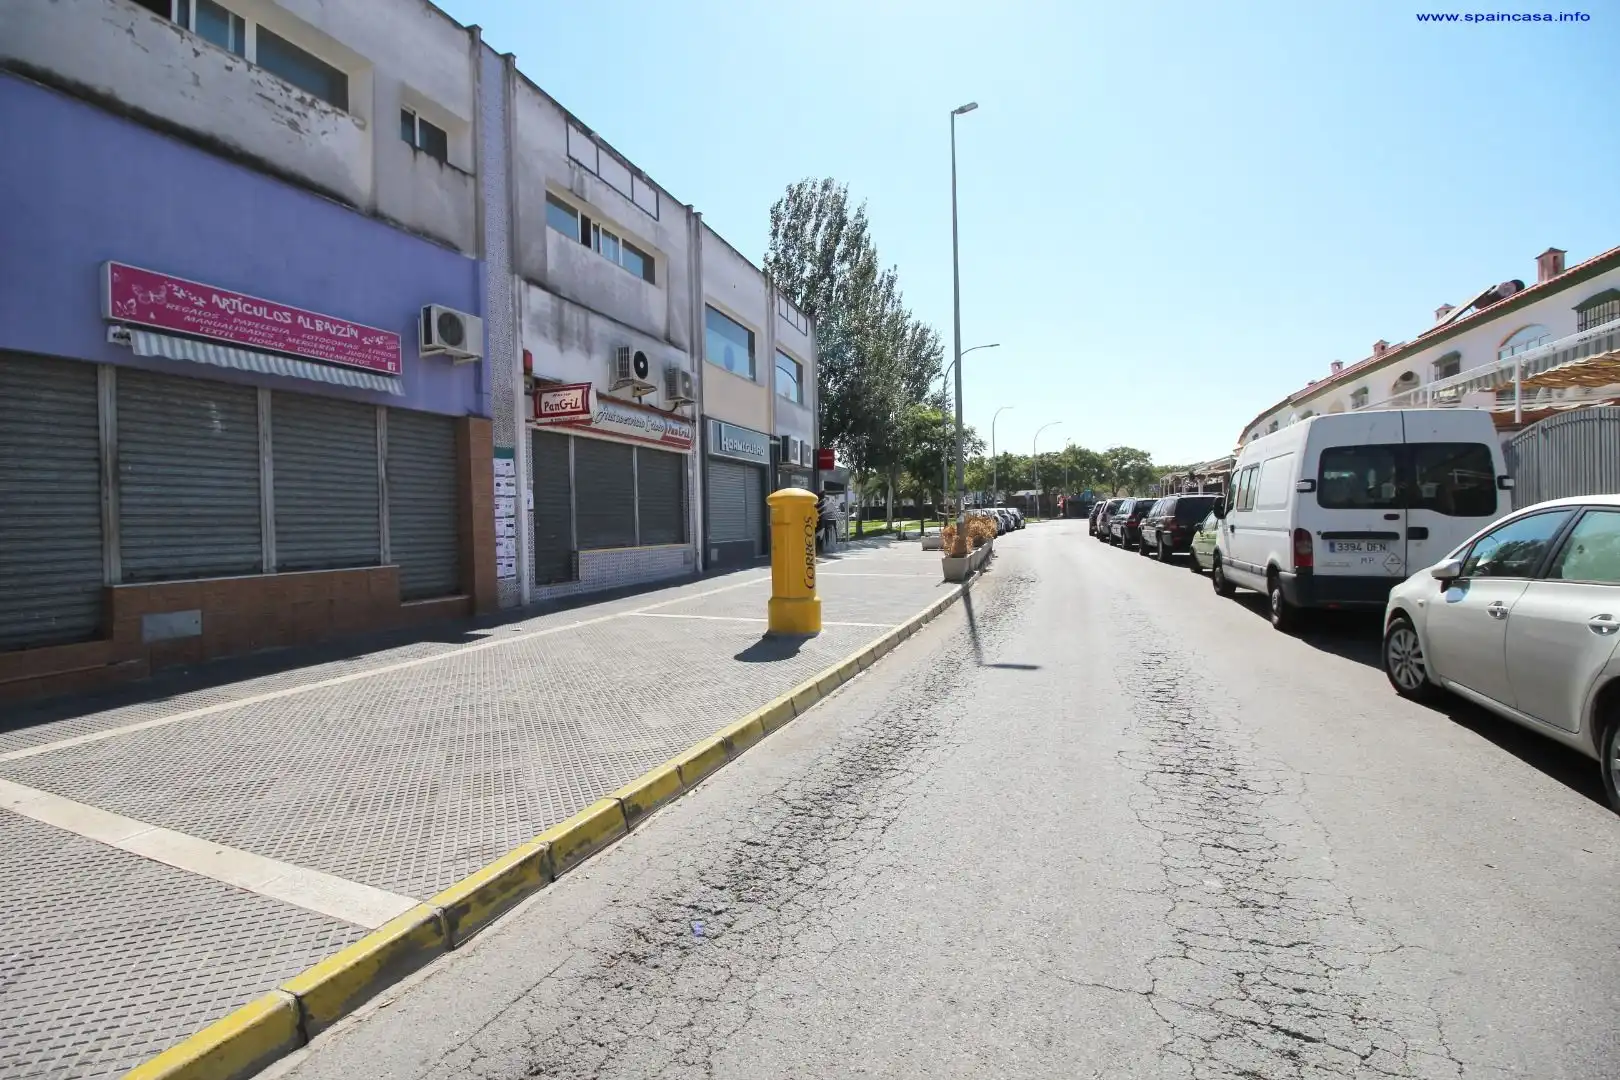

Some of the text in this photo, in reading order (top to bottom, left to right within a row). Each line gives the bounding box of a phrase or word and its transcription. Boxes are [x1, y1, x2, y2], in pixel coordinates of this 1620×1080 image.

[166, 302, 220, 319] REGALOS
[211, 293, 292, 324] ARTÍCULOS
[184, 315, 274, 338] MANUALIDADES
[200, 326, 370, 365] TEXTIL HOGAR COMPLEMENTOS
[804, 515, 816, 590] CORREOS
[1336, 542, 1362, 552] 3394
